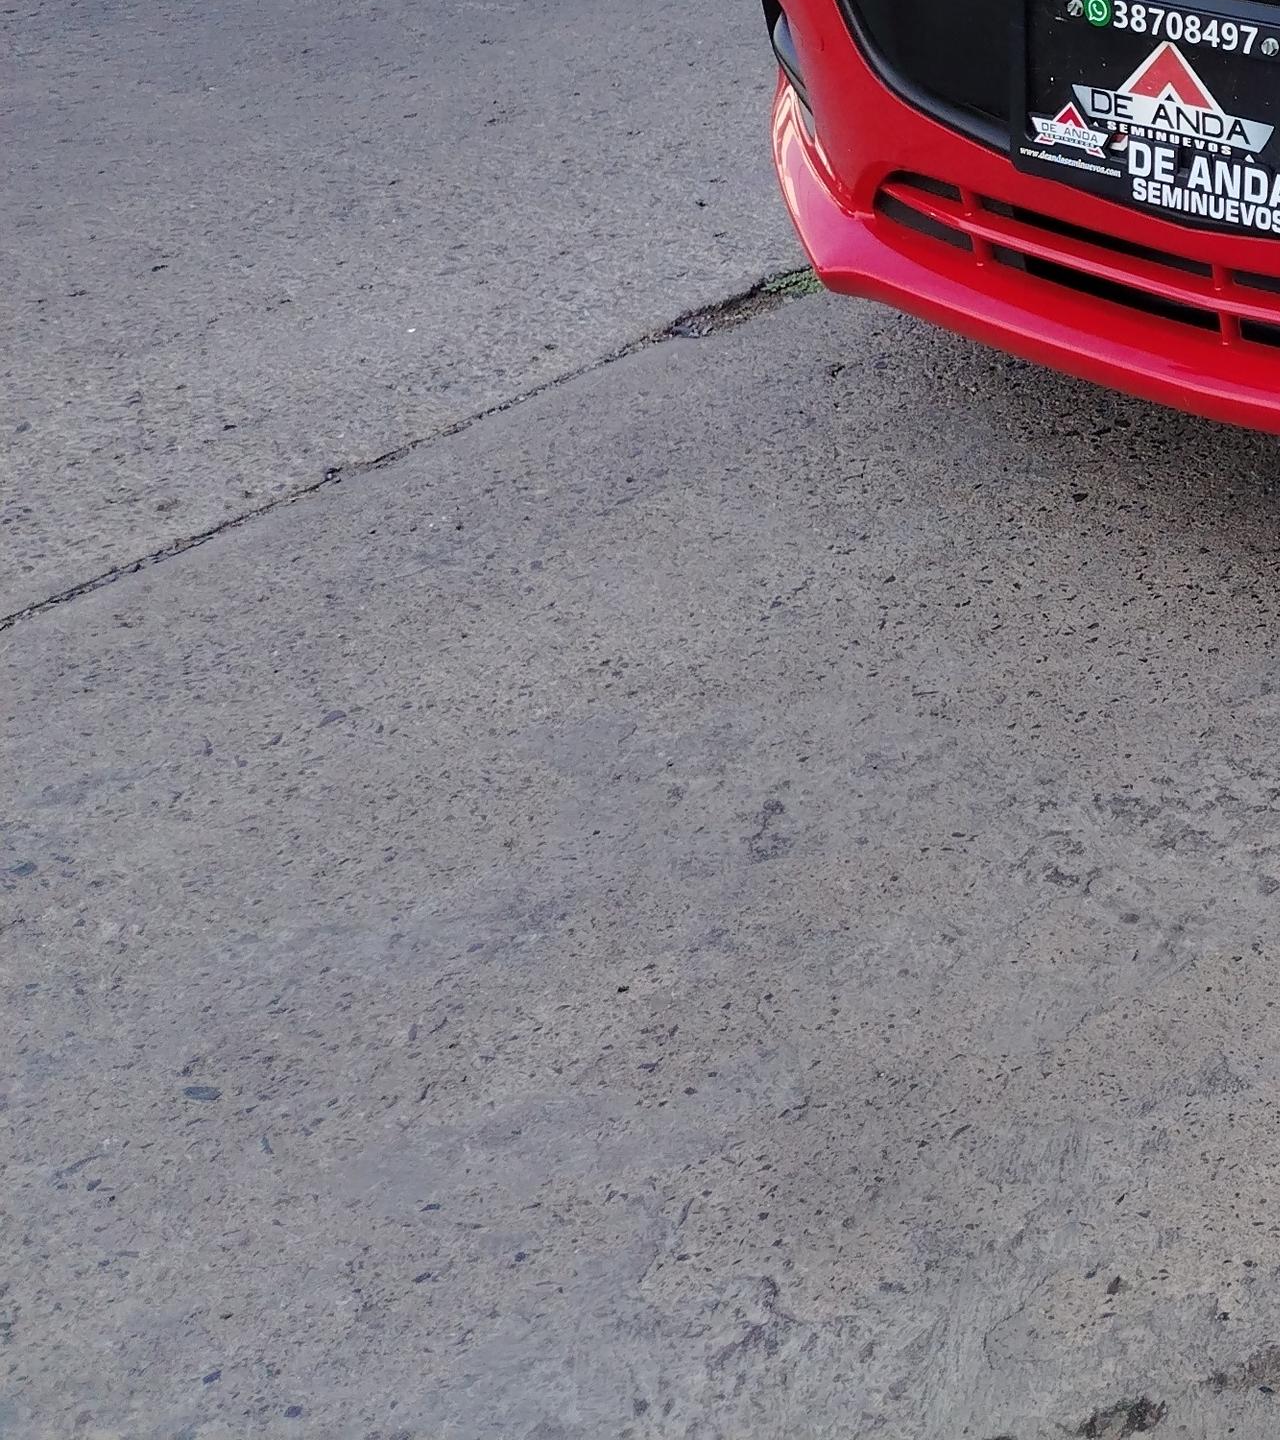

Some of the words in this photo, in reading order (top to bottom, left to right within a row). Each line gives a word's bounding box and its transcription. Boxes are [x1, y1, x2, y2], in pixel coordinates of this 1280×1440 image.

[1113, 0, 1258, 55] 38708497
[1041, 122, 1057, 133] DE
[1064, 127, 1098, 144] ANDA
[1091, 88, 1134, 120] DE
[1151, 102, 1251, 146] ANDA
[1107, 120, 1232, 156] SEMINUEVOS
[1128, 140, 1175, 184] DE
